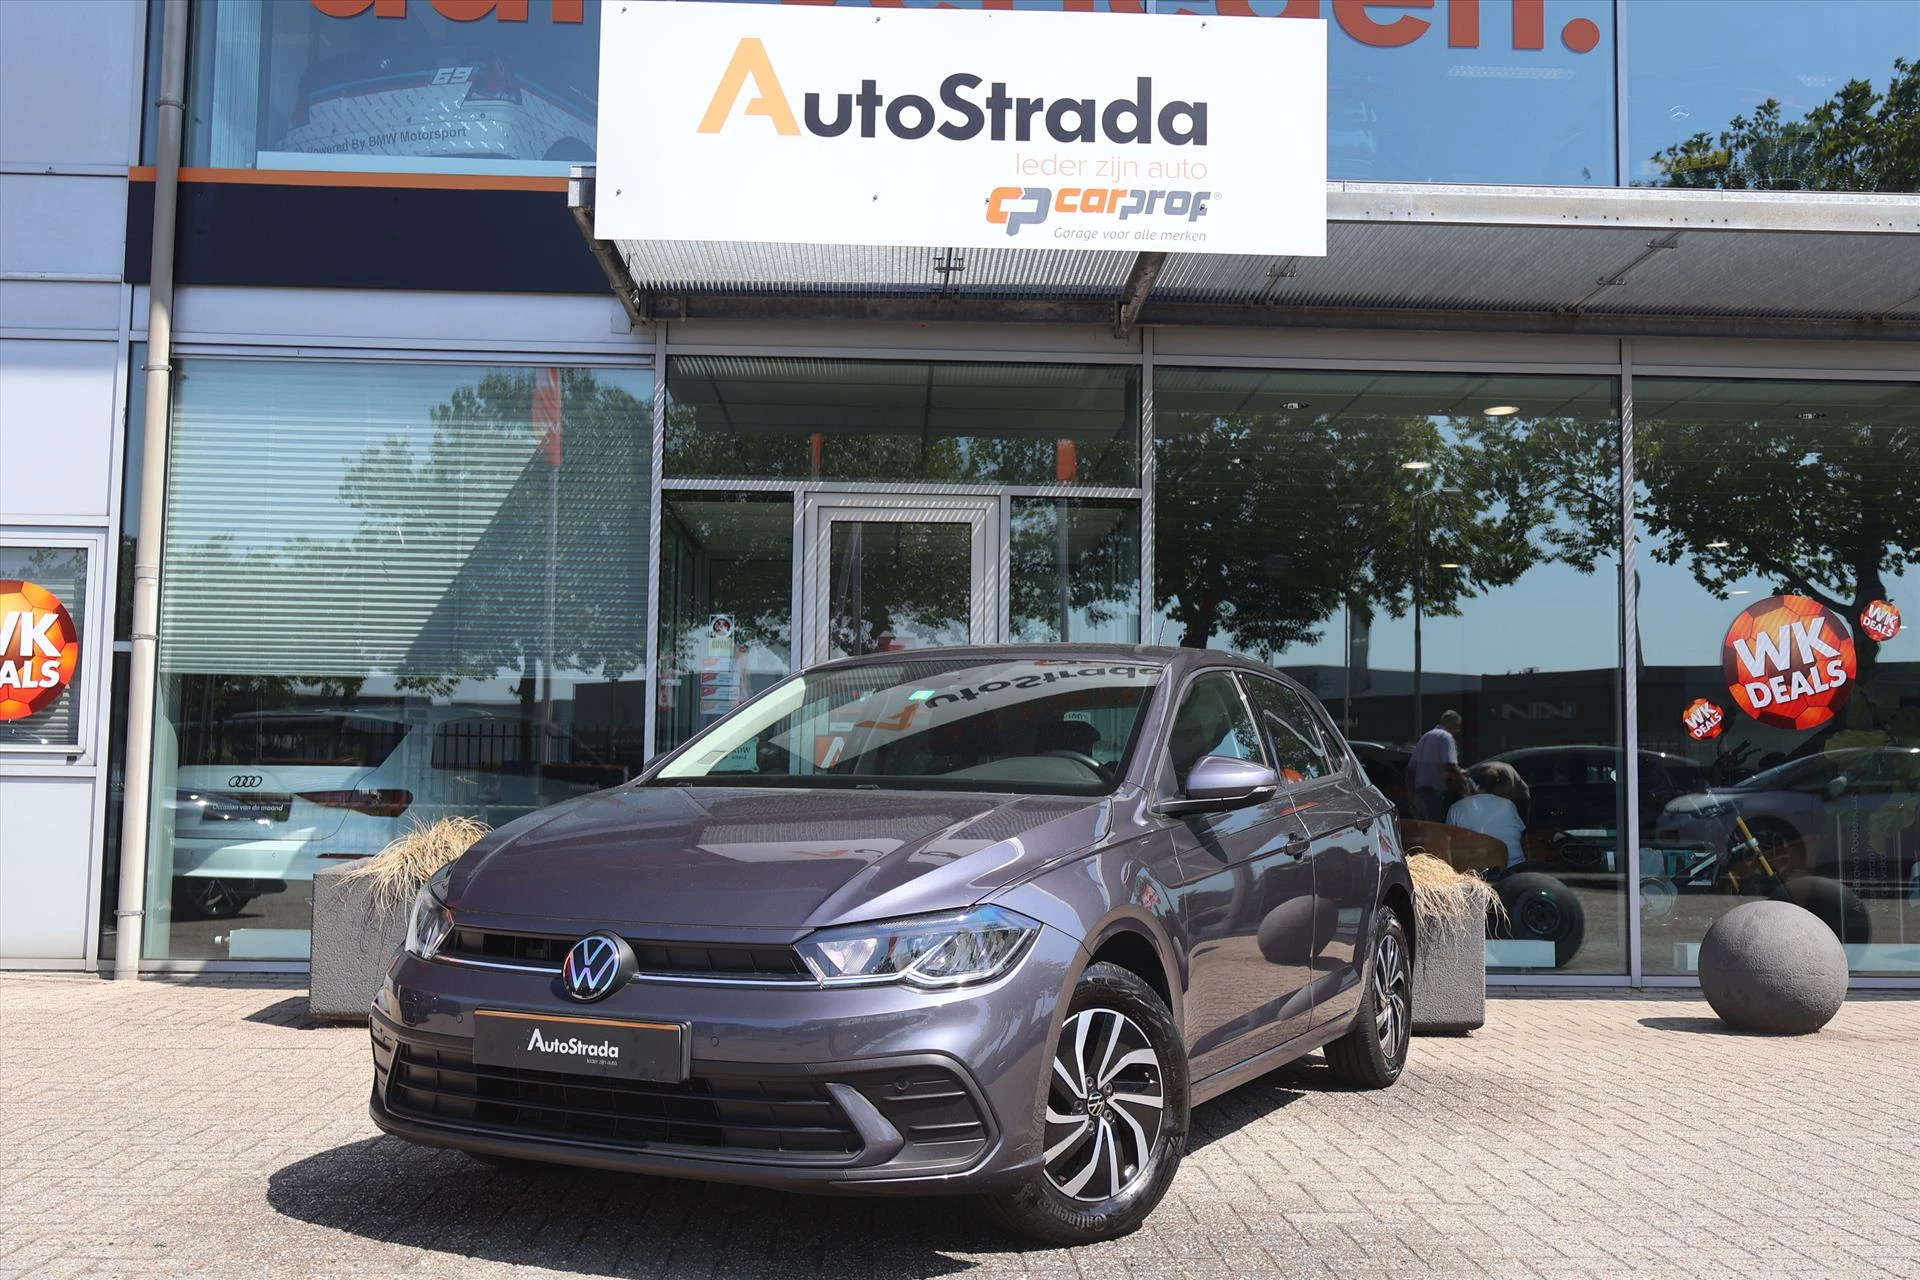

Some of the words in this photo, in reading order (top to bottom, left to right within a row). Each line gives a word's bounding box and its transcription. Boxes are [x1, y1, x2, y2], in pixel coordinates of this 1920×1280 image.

[697, 37, 1208, 146] AutoStrada
[351, 138, 366, 152] By
[368, 132, 397, 148] BMW
[400, 127, 467, 144] Motorsport
[1016, 154, 1087, 176] Ieder
[1095, 157, 1138, 182] zijn
[1148, 160, 1208, 180] auto
[1054, 227, 1098, 241] Garage
[1103, 230, 1131, 240] voor
[1134, 229, 1156, 241] alle
[1160, 230, 1207, 242] merken
[1863, 619, 1895, 637] DEALS
[1868, 604, 1899, 629] WK
[0, 612, 62, 657] K
[1733, 617, 1841, 678] WK
[0, 660, 61, 688] ALS
[1745, 660, 1847, 709] DEALS
[1685, 702, 1717, 726] WK
[1693, 712, 1722, 738] DEALS
[527, 1028, 619, 1058] AutoStrada
